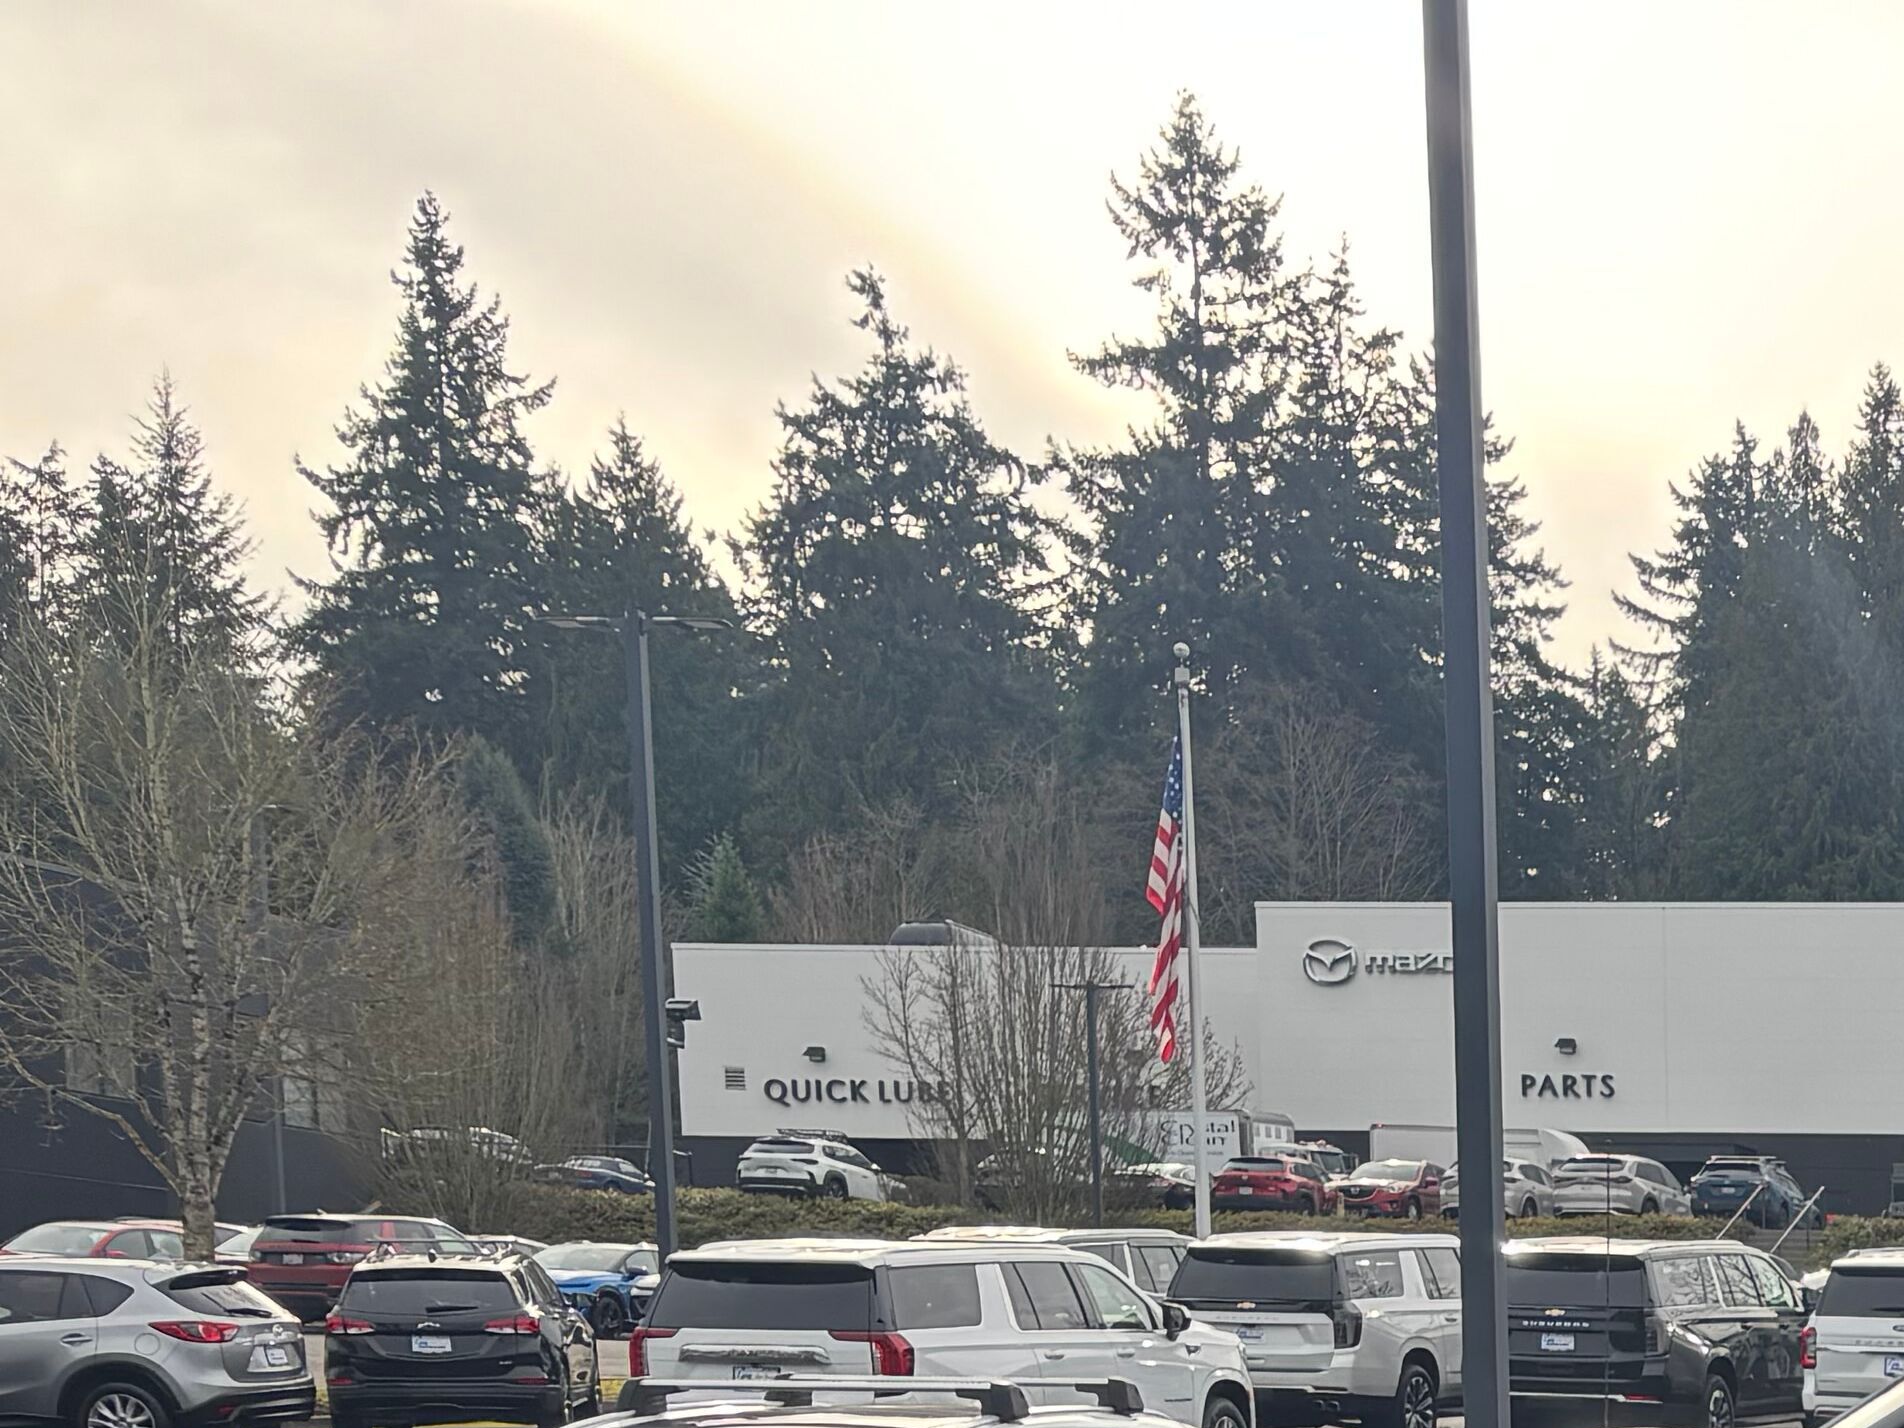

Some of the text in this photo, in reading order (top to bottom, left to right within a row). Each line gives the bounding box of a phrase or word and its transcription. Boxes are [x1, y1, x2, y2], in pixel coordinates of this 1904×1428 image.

[1364, 953, 1453, 974] maz
[763, 1078, 869, 1108] QUICK
[1521, 1073, 1616, 1099] PARTS
